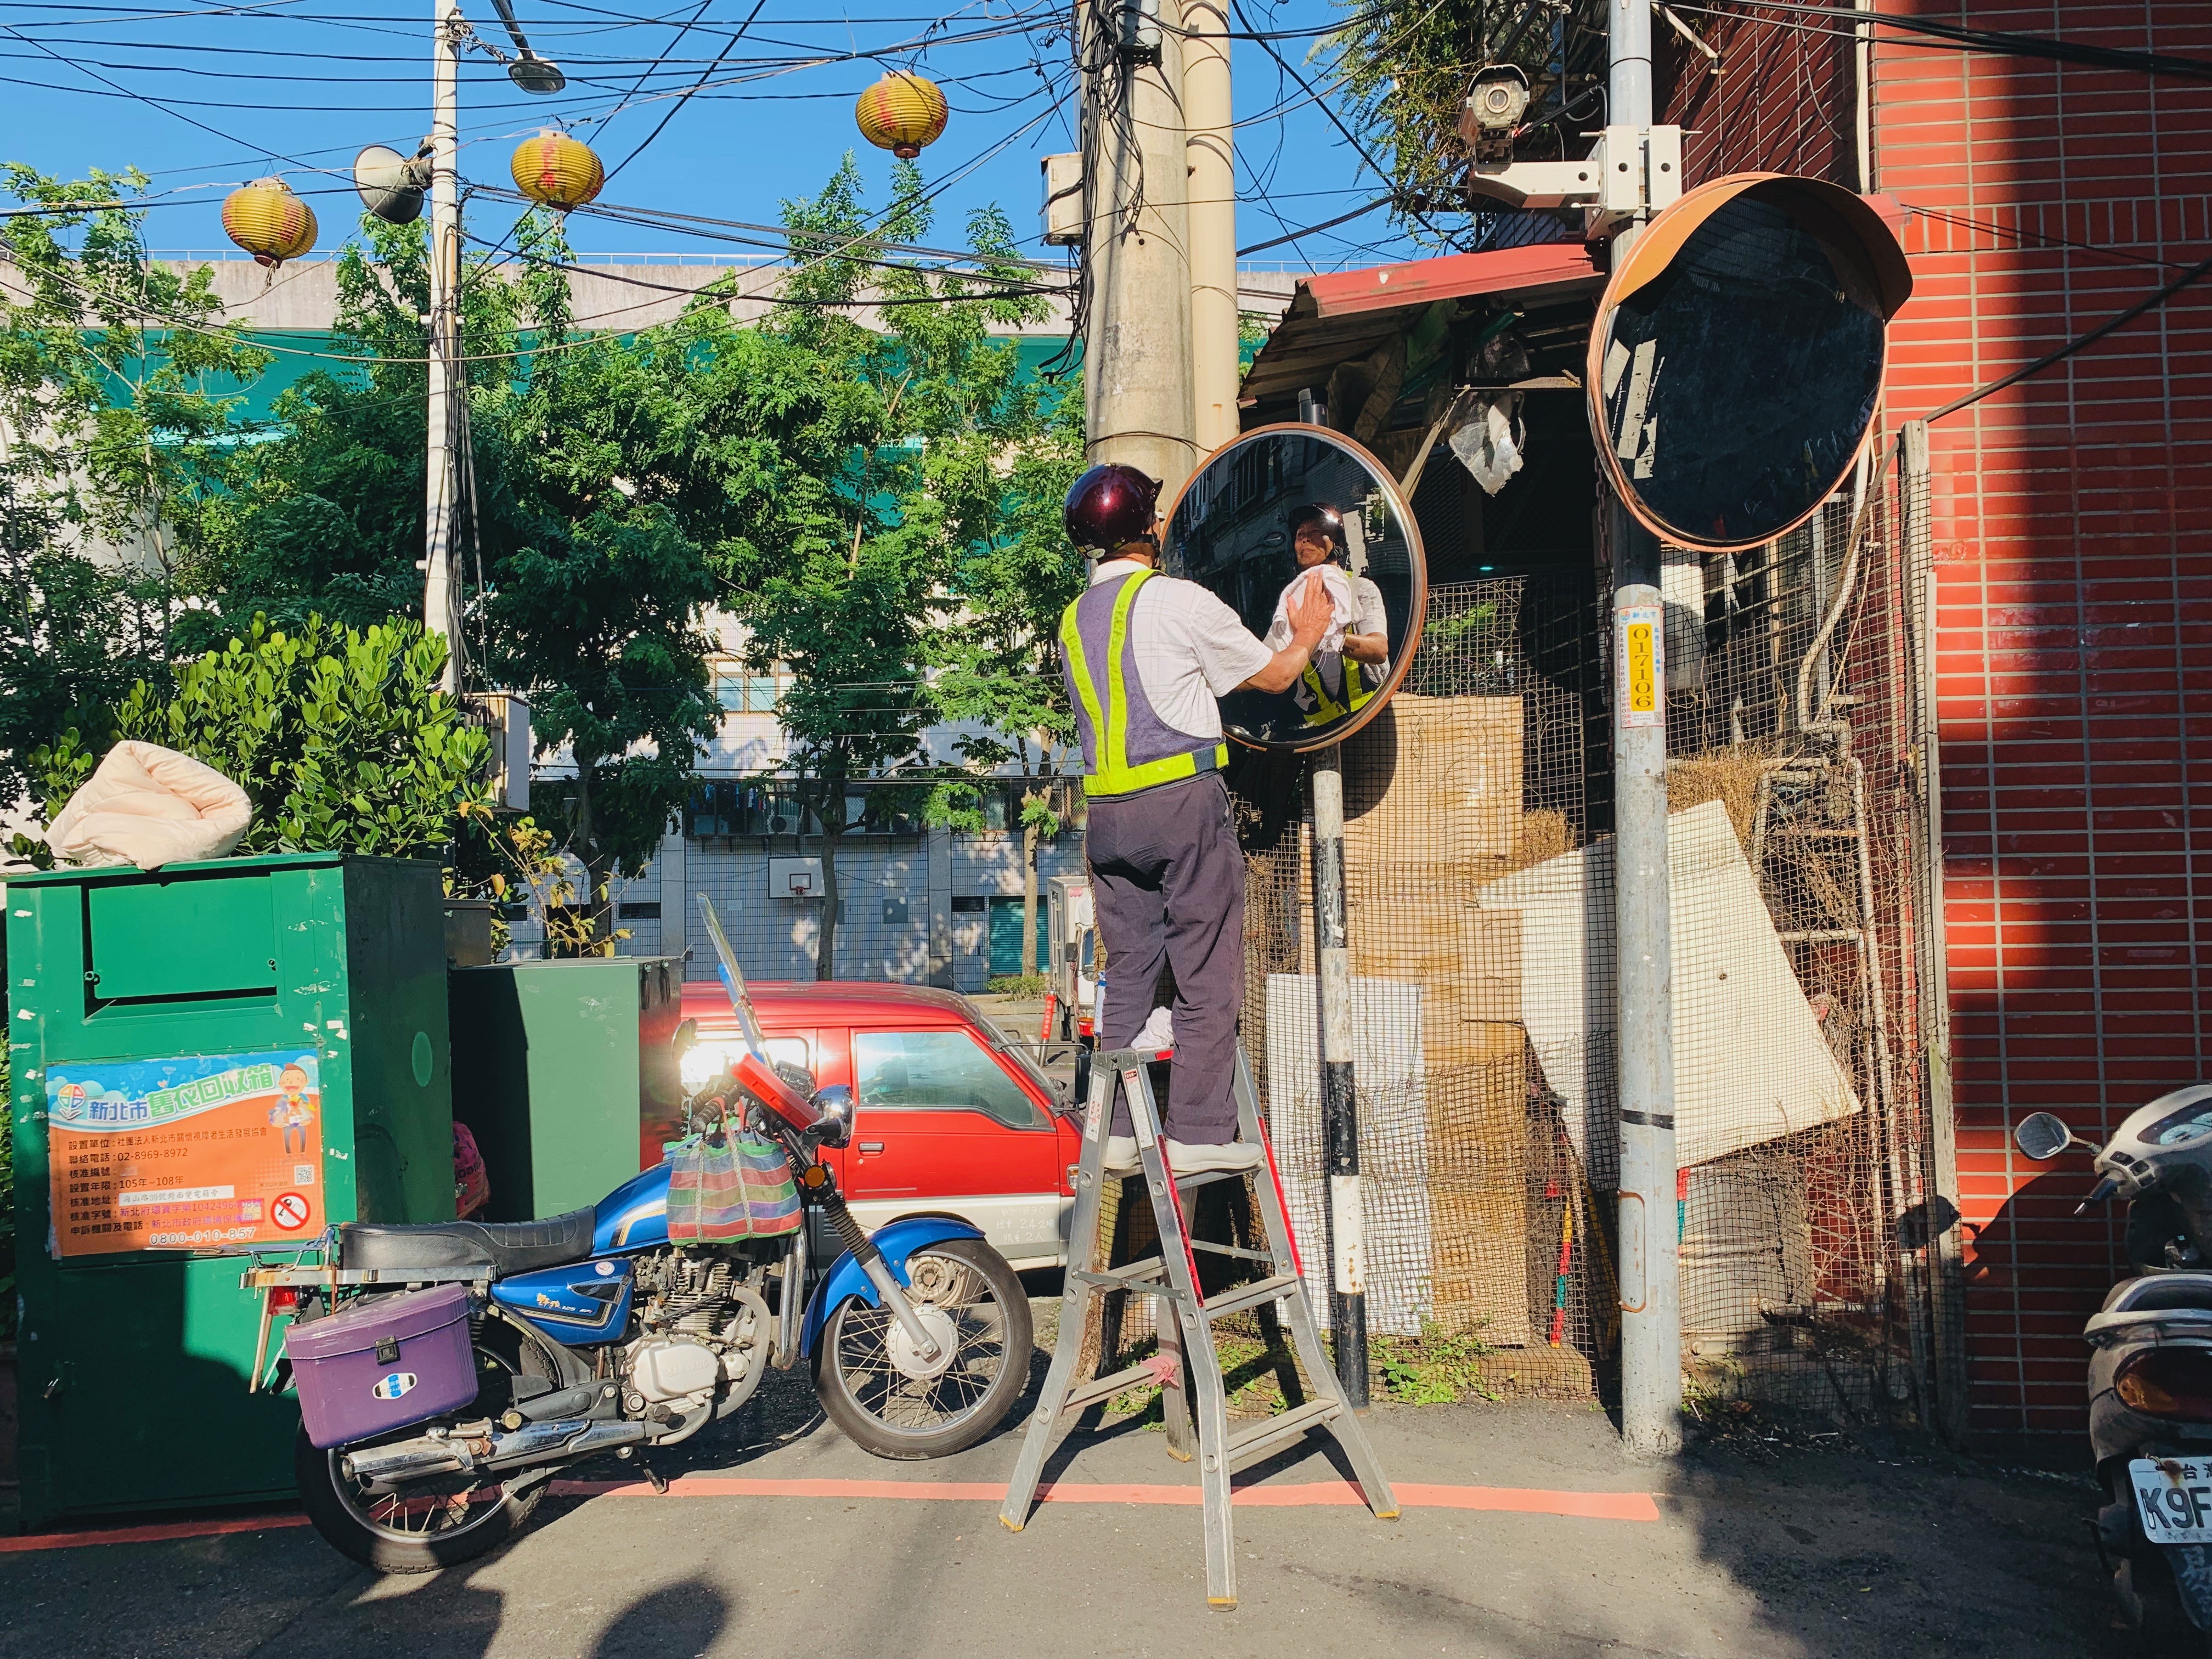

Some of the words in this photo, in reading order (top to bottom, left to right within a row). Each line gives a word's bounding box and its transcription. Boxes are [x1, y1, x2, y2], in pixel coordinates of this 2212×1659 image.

[1633, 628, 1651, 708] 017106
[117, 1148, 188, 1161] 02-8969-8972
[150, 1228, 256, 1245] 0800-010-857
[668, 1358, 709, 1378] SANYANG
[2140, 1486, 2211, 1530] K9F
